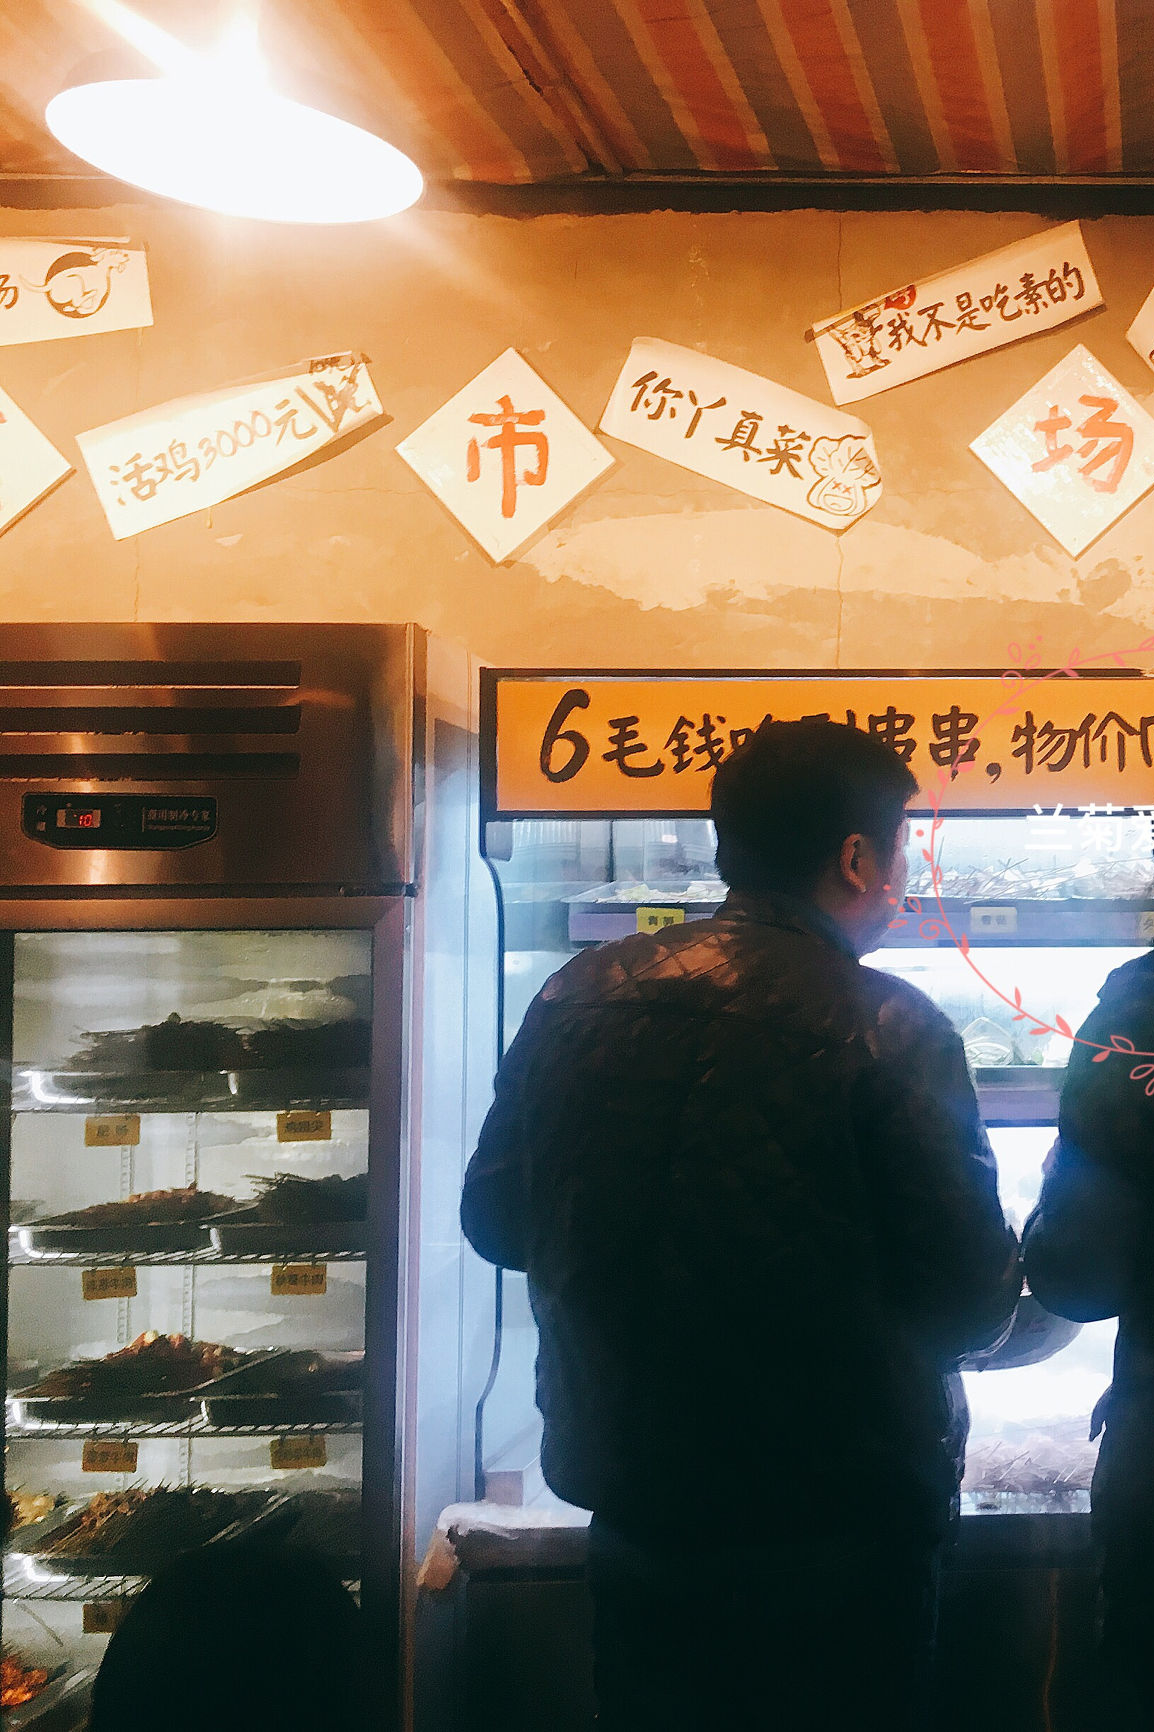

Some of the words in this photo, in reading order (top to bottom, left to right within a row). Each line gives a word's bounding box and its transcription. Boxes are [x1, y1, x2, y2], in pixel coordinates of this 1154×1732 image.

[886, 261, 1086, 352] 我不是吃素的
[108, 398, 318, 505] 活鸡3000元
[466, 394, 549, 519] 市
[630, 370, 812, 481] 你丫真菜
[1031, 394, 1136, 494] 场
